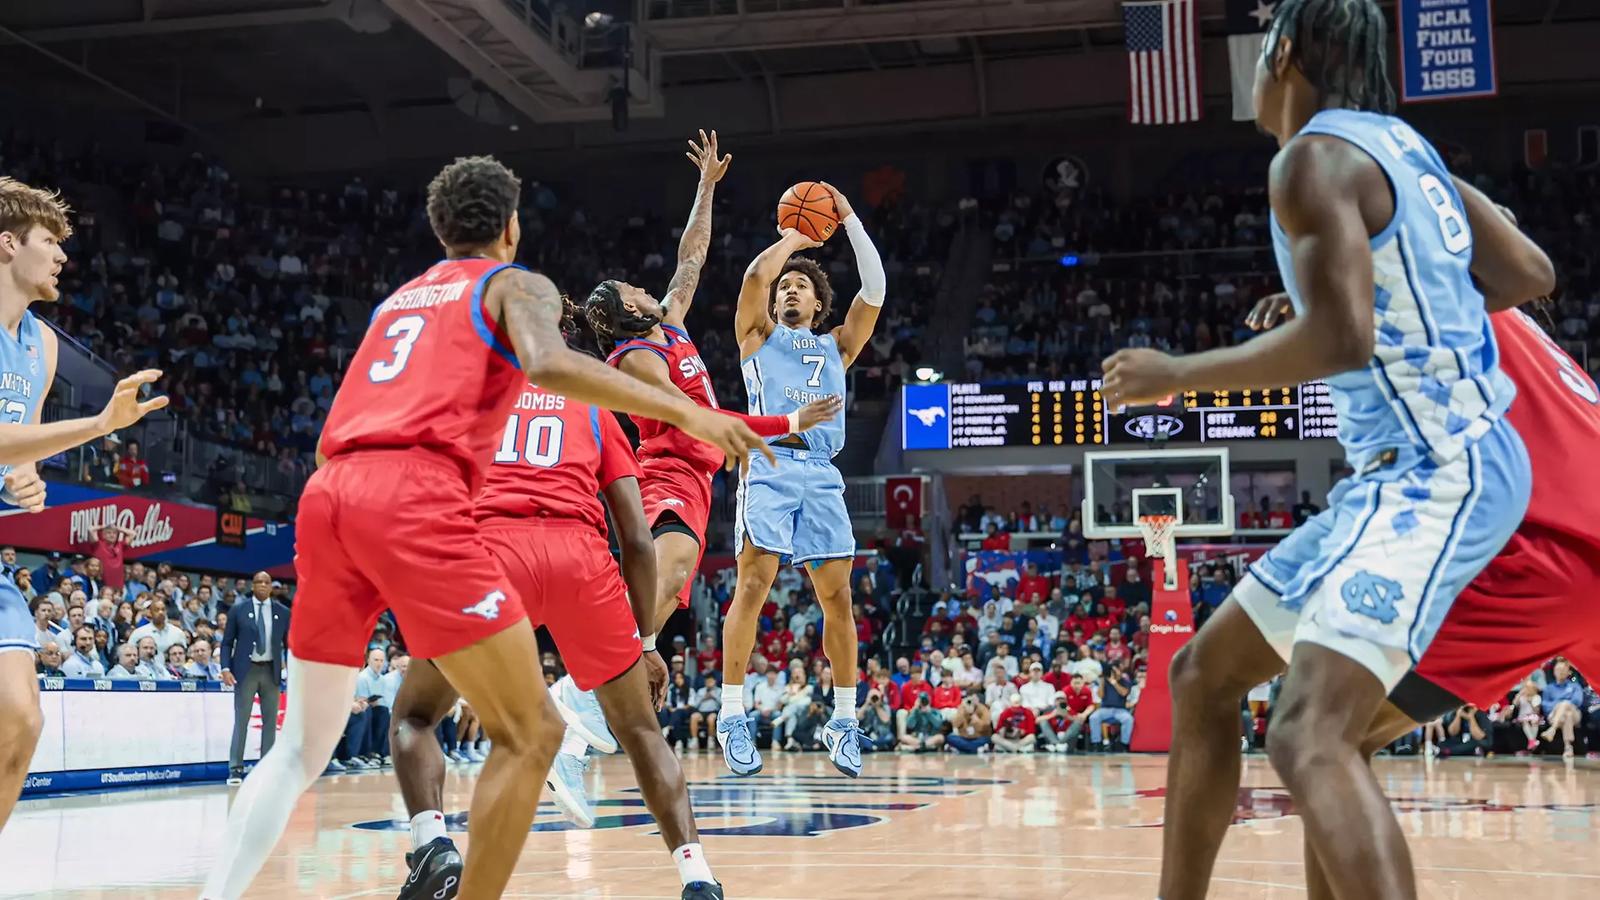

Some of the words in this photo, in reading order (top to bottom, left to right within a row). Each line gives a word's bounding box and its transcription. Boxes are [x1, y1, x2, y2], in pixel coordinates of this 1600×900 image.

[1418, 9, 1472, 28] NCAA
[1416, 28, 1476, 48] FINAL
[1421, 48, 1474, 67] FOUR
[1421, 67, 1476, 91] 1956
[1418, 172, 1472, 255] 8
[368, 314, 425, 385] 3
[679, 354, 707, 379] SM
[802, 354, 826, 387] 7
[784, 385, 843, 405] CARO
[1207, 413, 1236, 425] STET
[1260, 425, 1277, 437] 41
[494, 413, 564, 468] 10
[70, 506, 100, 545] PONY
[117, 503, 173, 548] Dallas
[1150, 623, 1173, 635] Origin
[1173, 623, 1192, 633] Bank
